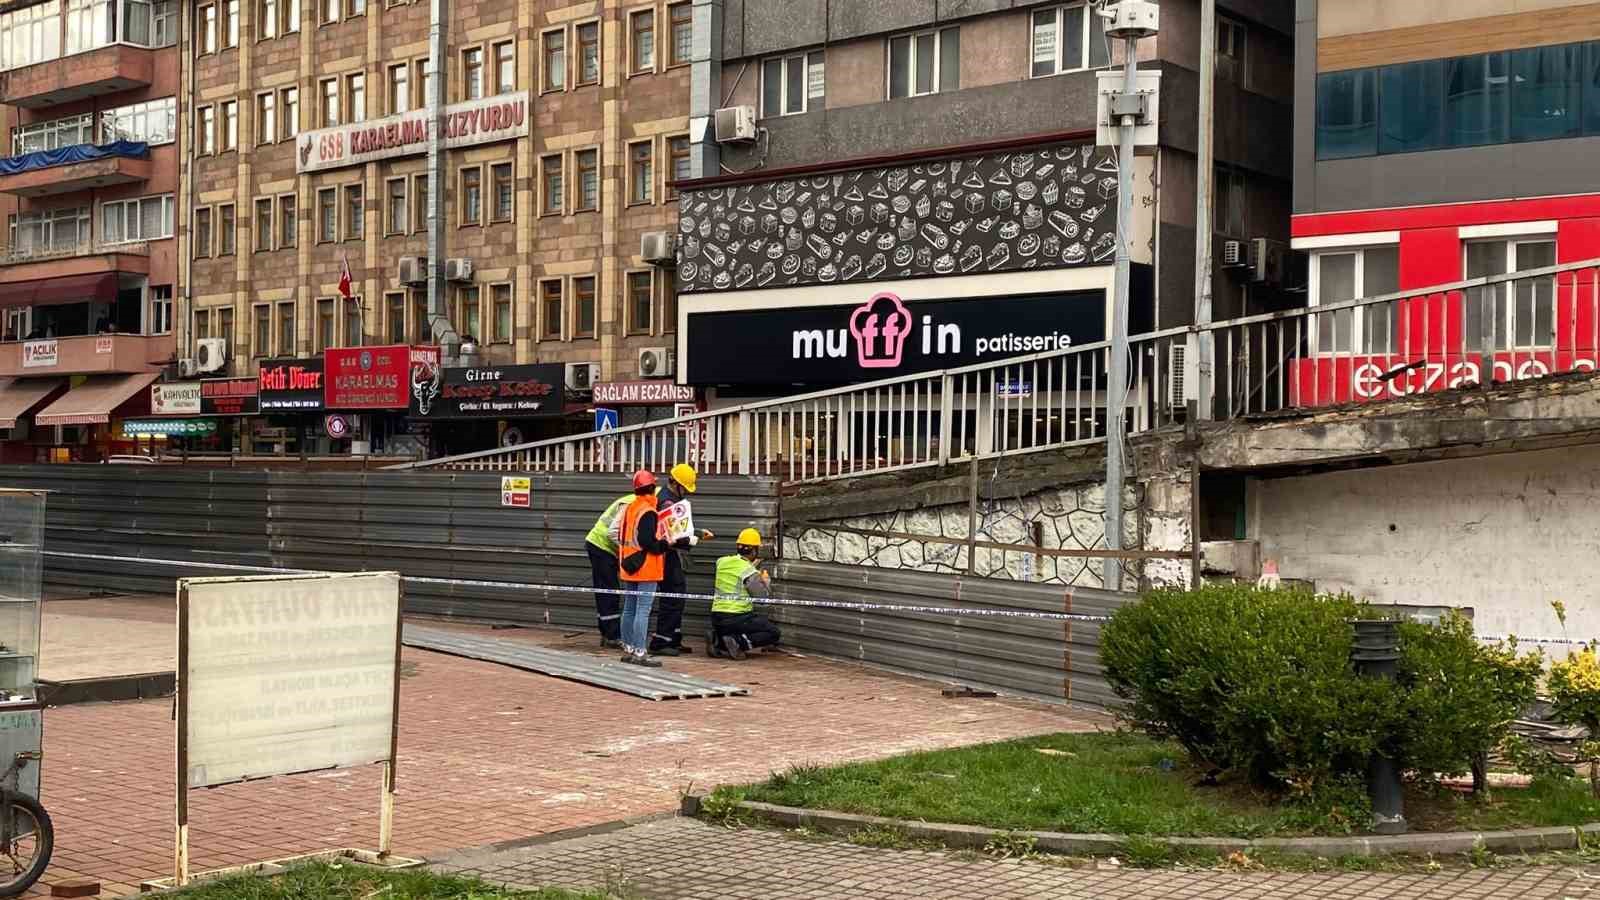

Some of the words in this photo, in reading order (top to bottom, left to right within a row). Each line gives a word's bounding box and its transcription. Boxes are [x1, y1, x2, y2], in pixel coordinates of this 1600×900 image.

[319, 132, 344, 161] GSB
[350, 118, 430, 155] KARAELMA
[975, 331, 1072, 356] patisserie
[260, 365, 286, 390] Fetih
[288, 366, 321, 390] Döner
[335, 374, 399, 390] KARAELMAS
[465, 369, 501, 382] Girne
[593, 383, 639, 401] SAĞLAM
